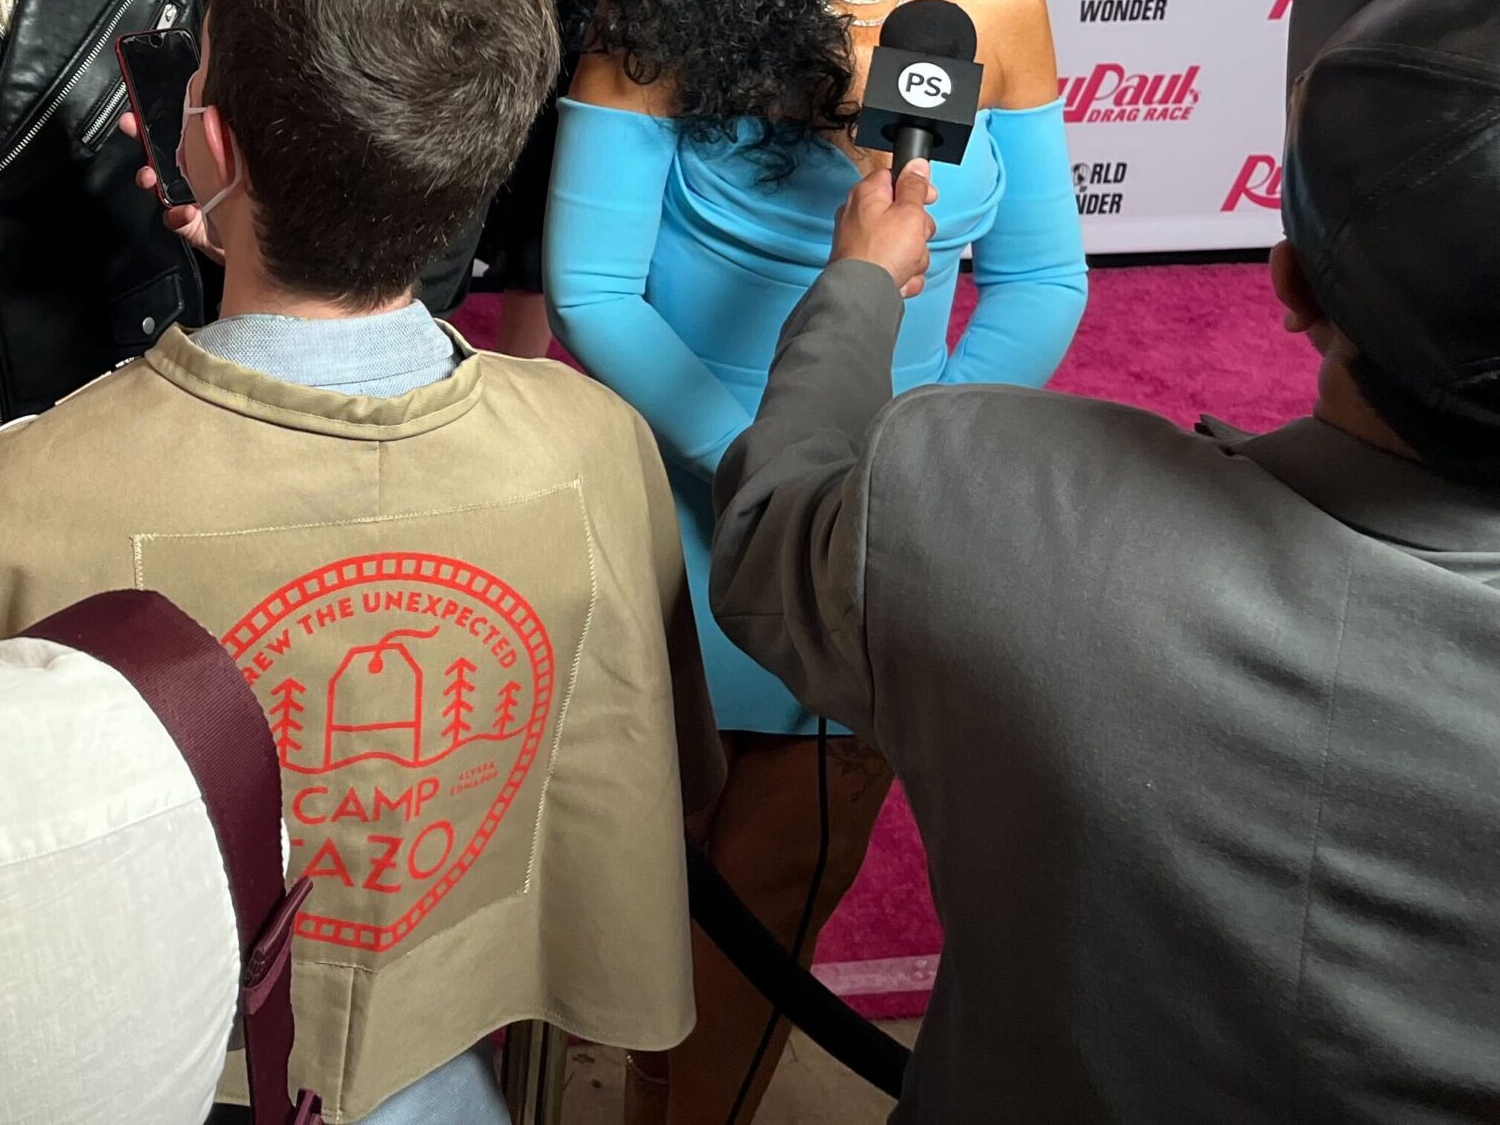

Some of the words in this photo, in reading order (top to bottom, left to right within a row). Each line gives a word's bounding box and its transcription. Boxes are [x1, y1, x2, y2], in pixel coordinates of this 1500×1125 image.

[1087, 108, 1138, 123] DRAG
[1143, 106, 1194, 121] RACE
[297, 597, 355, 636] THE
[362, 590, 518, 670] UNEXPECTED
[291, 776, 441, 825] CAMP
